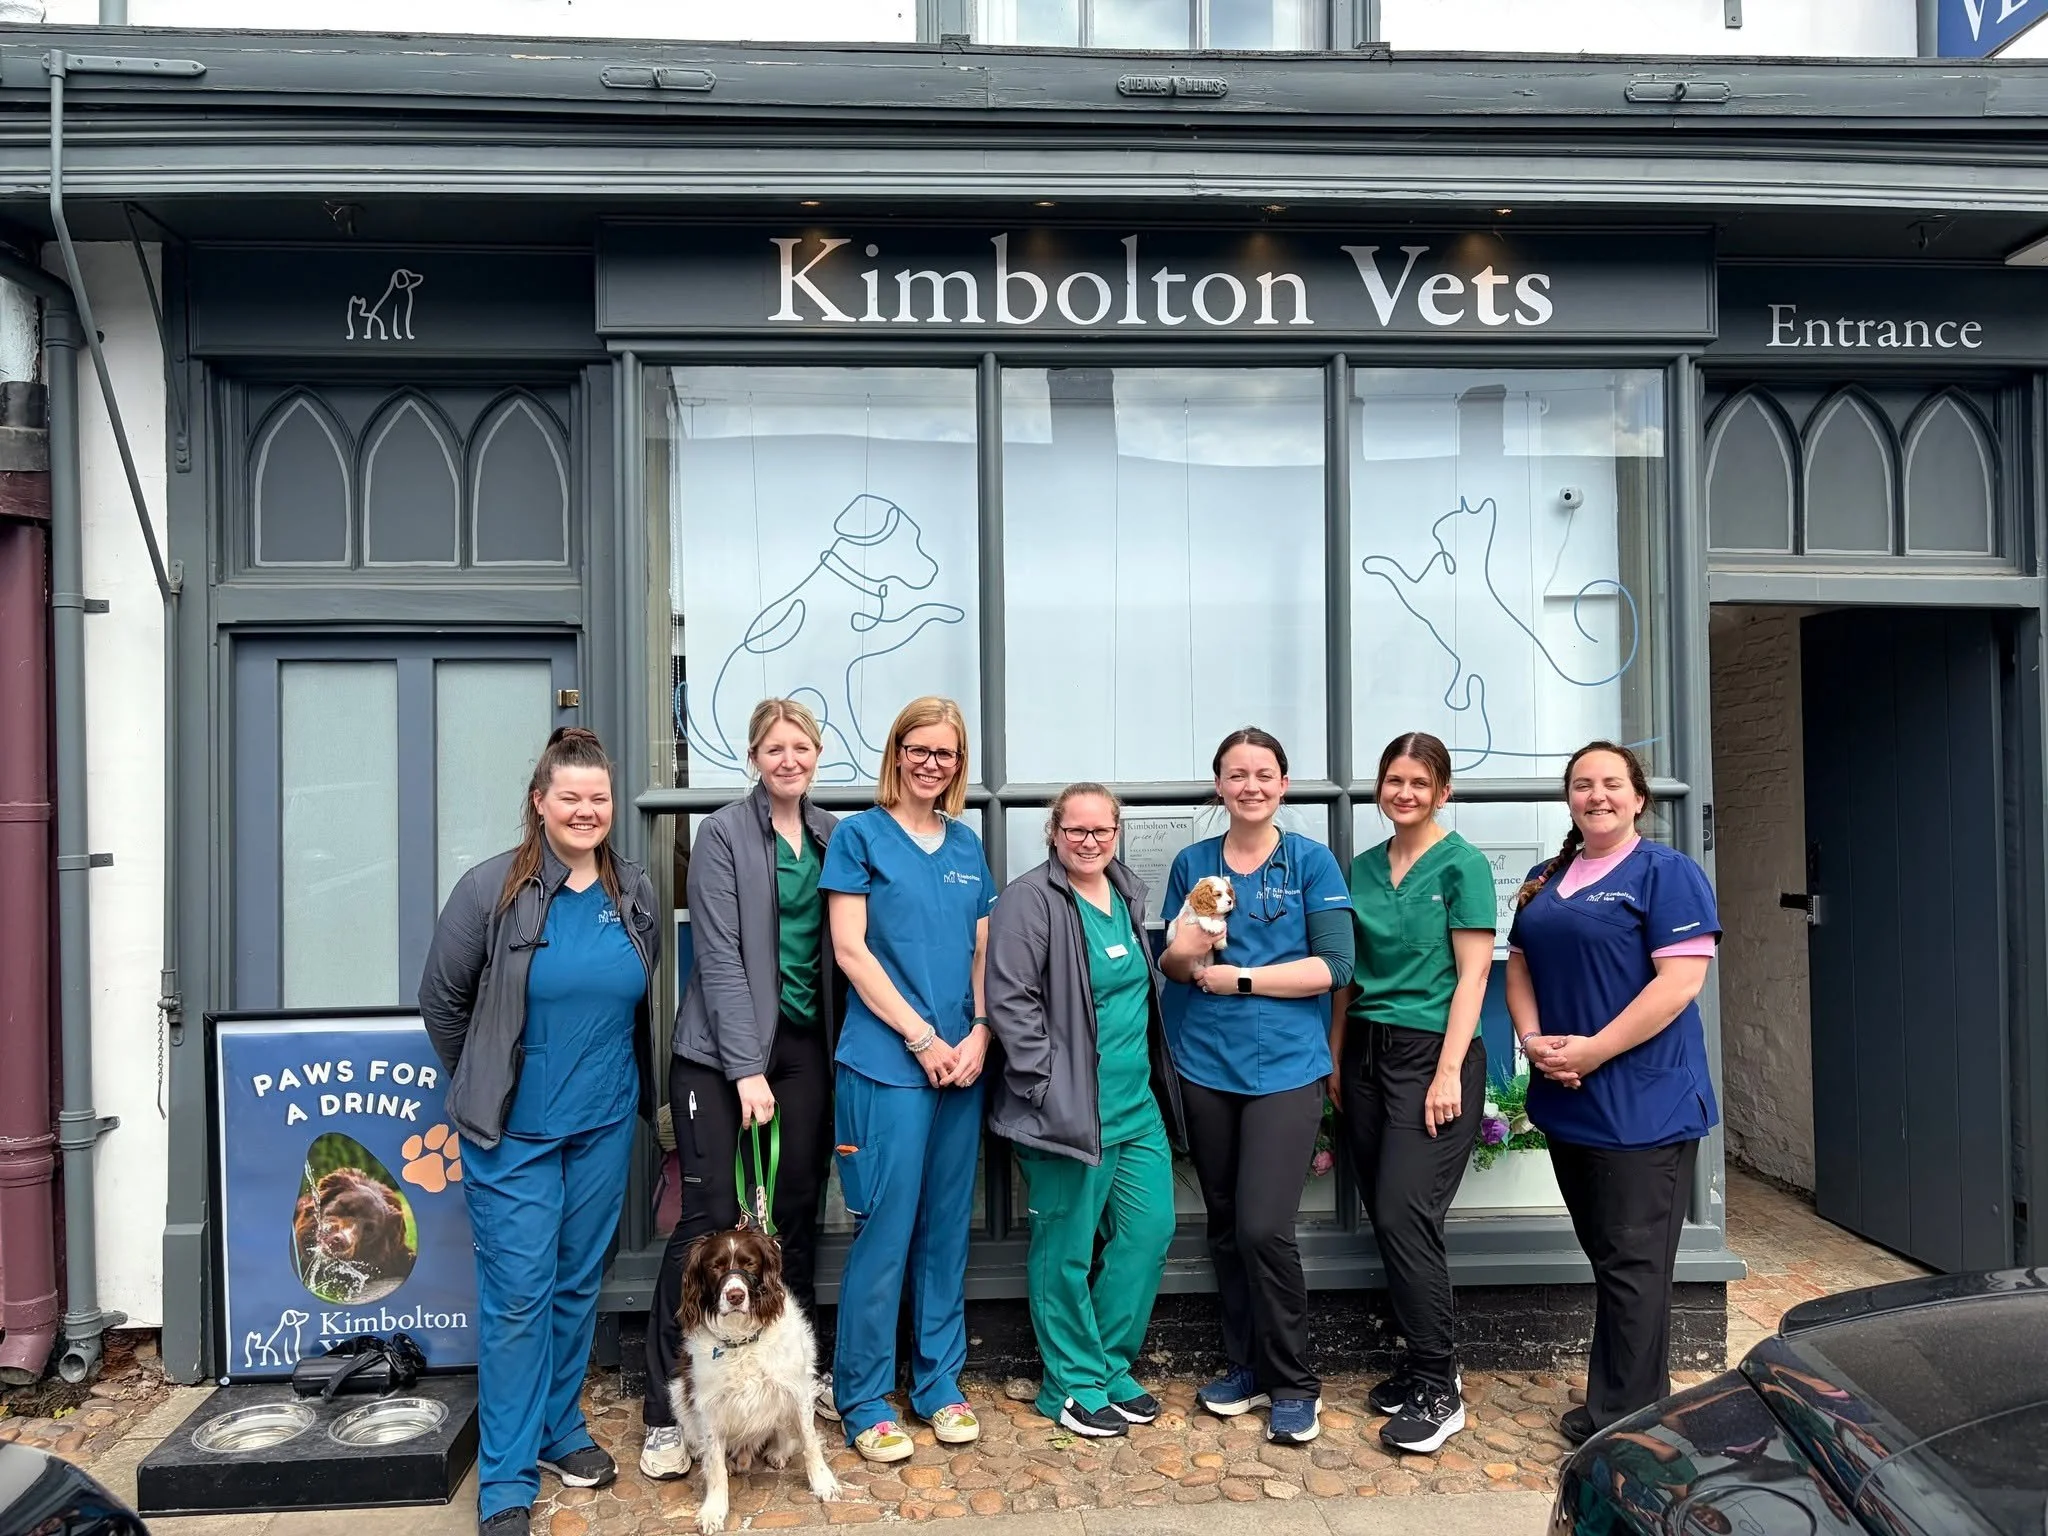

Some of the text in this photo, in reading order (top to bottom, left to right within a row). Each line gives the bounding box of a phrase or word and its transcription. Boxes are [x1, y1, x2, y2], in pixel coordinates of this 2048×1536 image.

[768, 232, 1555, 327] Kimbolton Vets
[1766, 304, 1983, 349] Entrance
[1127, 821, 1188, 830] Kimbolton Vets
[253, 1060, 437, 1097] PAWS FOR
[286, 1092, 421, 1126] A DRINK
[319, 1305, 468, 1336] Kimbolton
